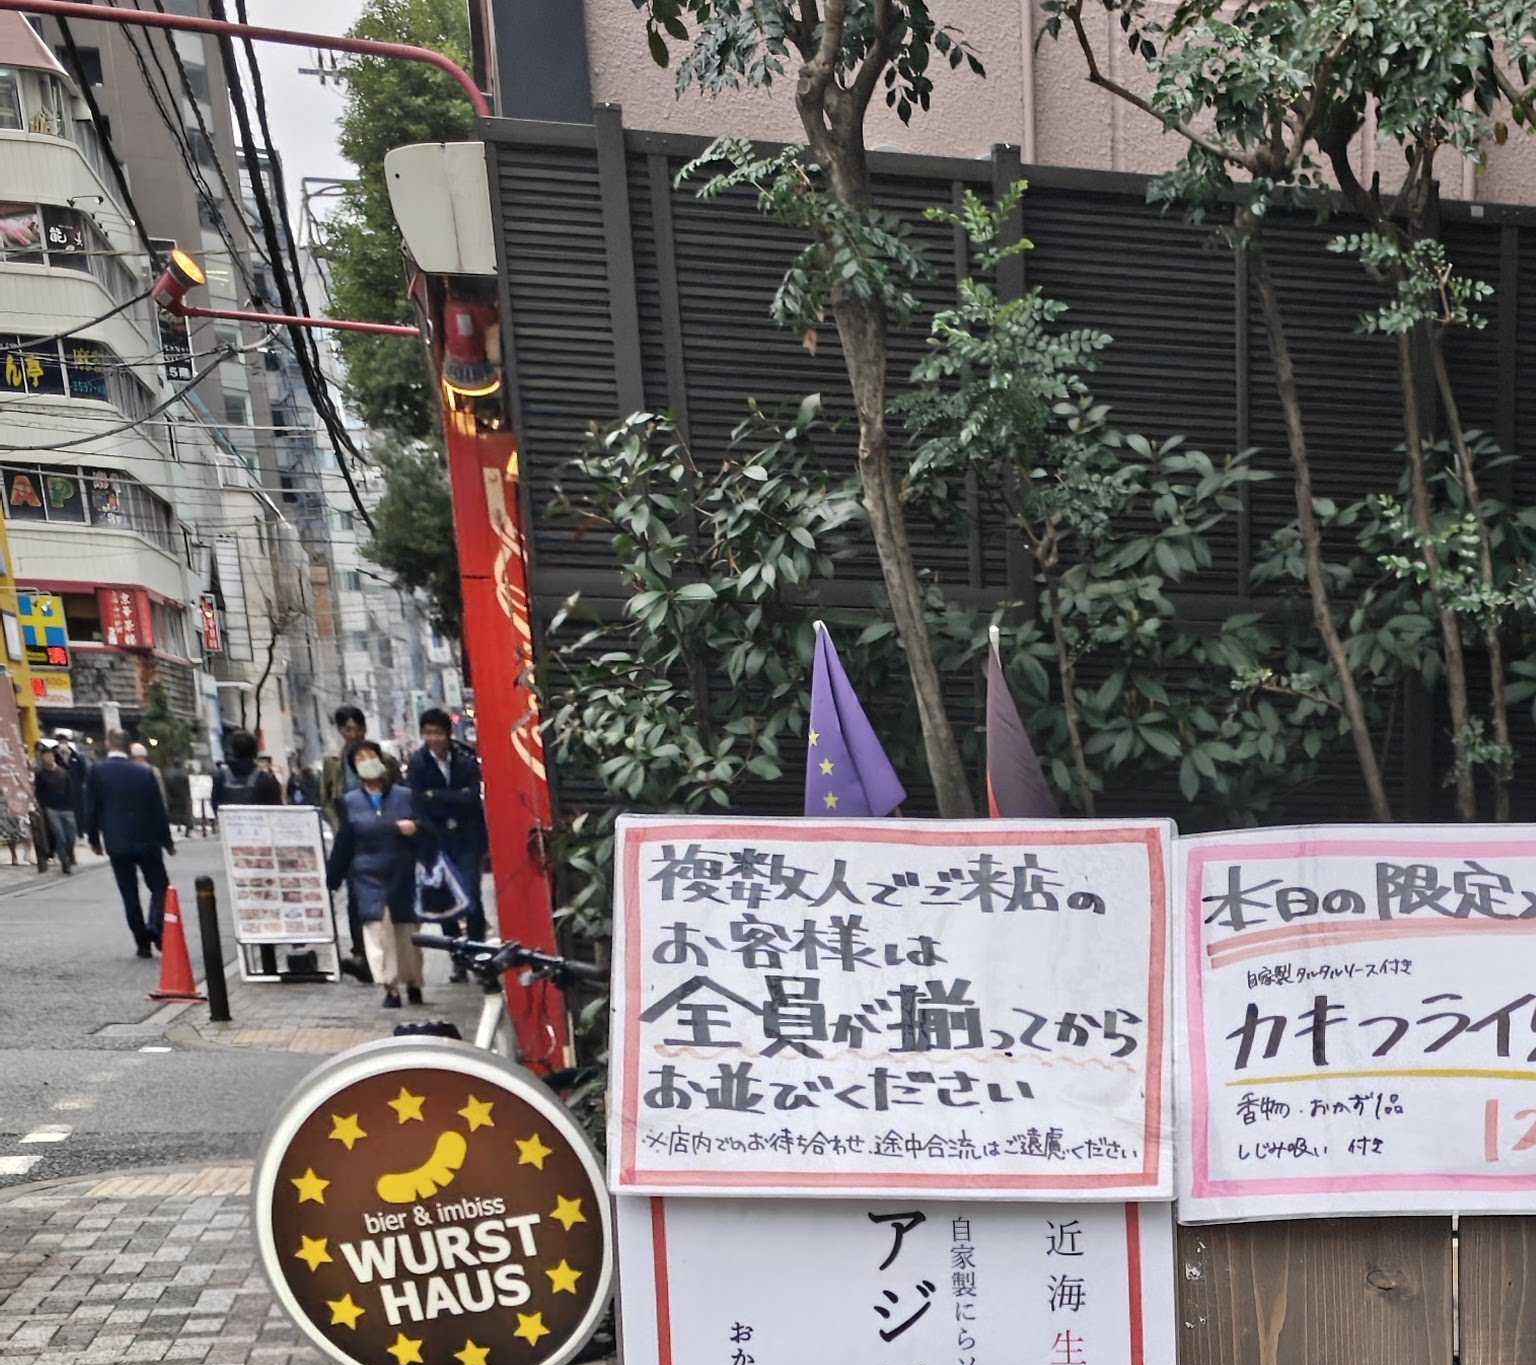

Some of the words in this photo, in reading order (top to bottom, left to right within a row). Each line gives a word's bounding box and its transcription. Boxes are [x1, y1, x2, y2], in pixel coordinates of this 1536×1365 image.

[647, 845, 1106, 914] 複数人でご来店の
[652, 914, 949, 971] お客様は
[638, 975, 1144, 1059] 全員が揃ってから
[643, 1062, 1035, 1114] お並びください
[1348, 1136, 1384, 1155] 付き
[365, 1209, 406, 1234] bier
[413, 1205, 433, 1227] &
[437, 1197, 506, 1223] imbiss
[340, 1214, 541, 1284] WURST
[380, 1265, 532, 1325] HAUS
